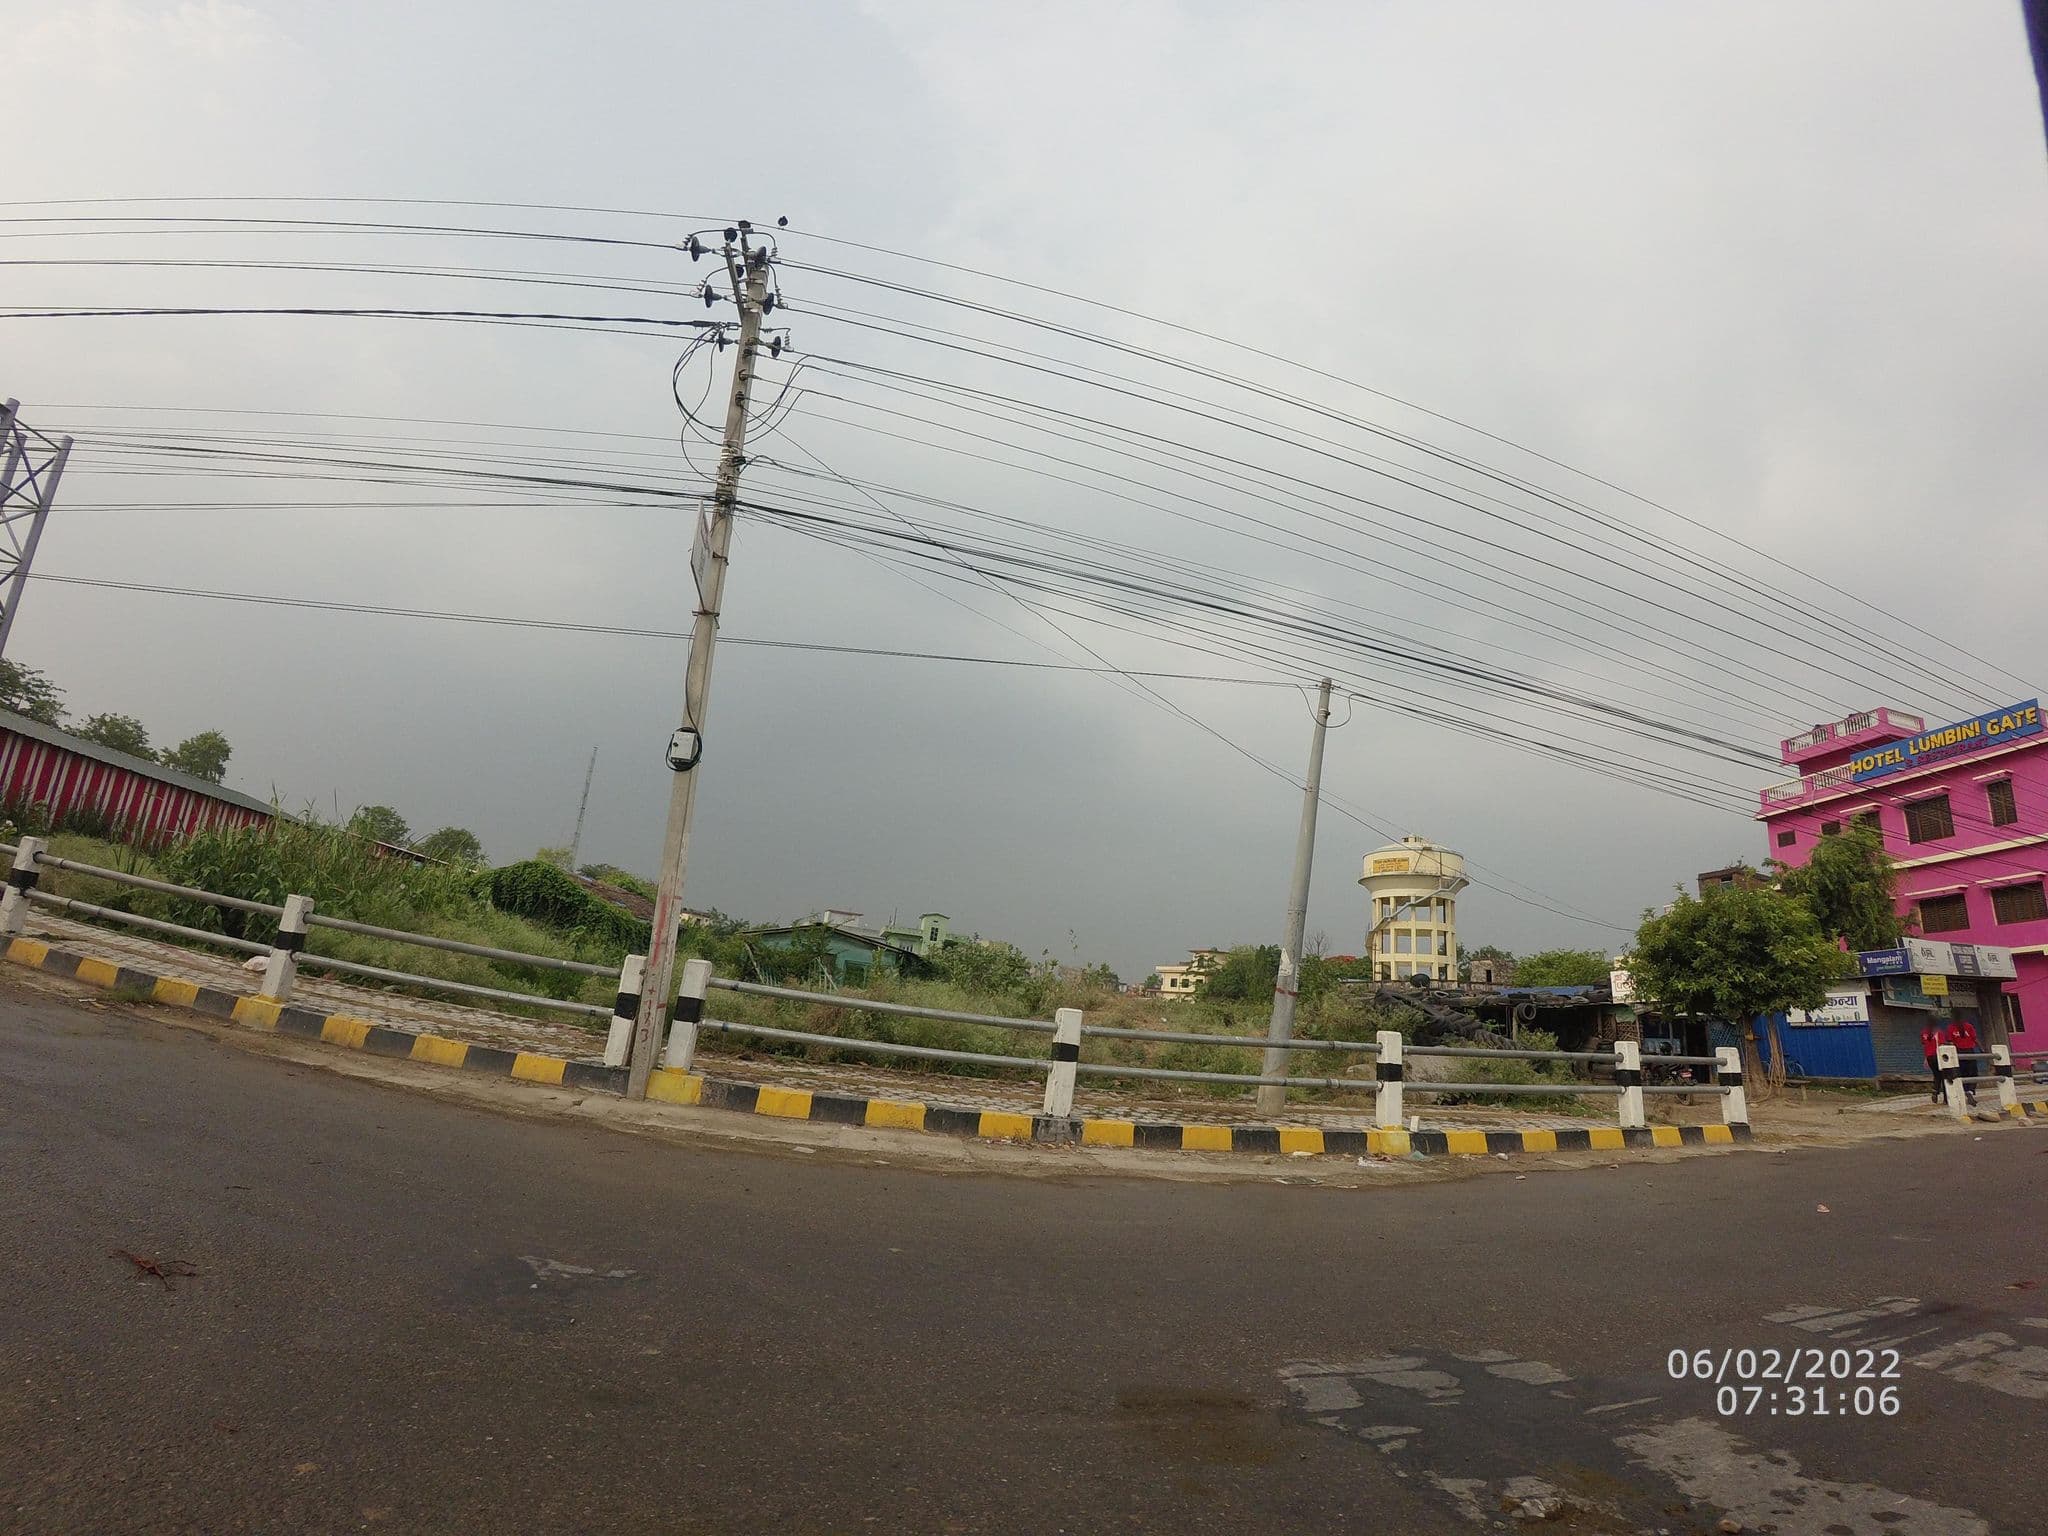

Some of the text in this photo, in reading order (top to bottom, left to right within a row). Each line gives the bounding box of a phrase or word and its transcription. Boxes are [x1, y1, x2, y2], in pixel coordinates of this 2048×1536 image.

[1850, 748, 1905, 775] HOTEL
[1909, 720, 1982, 755] LUMBINI
[1986, 706, 2038, 735] GATE
